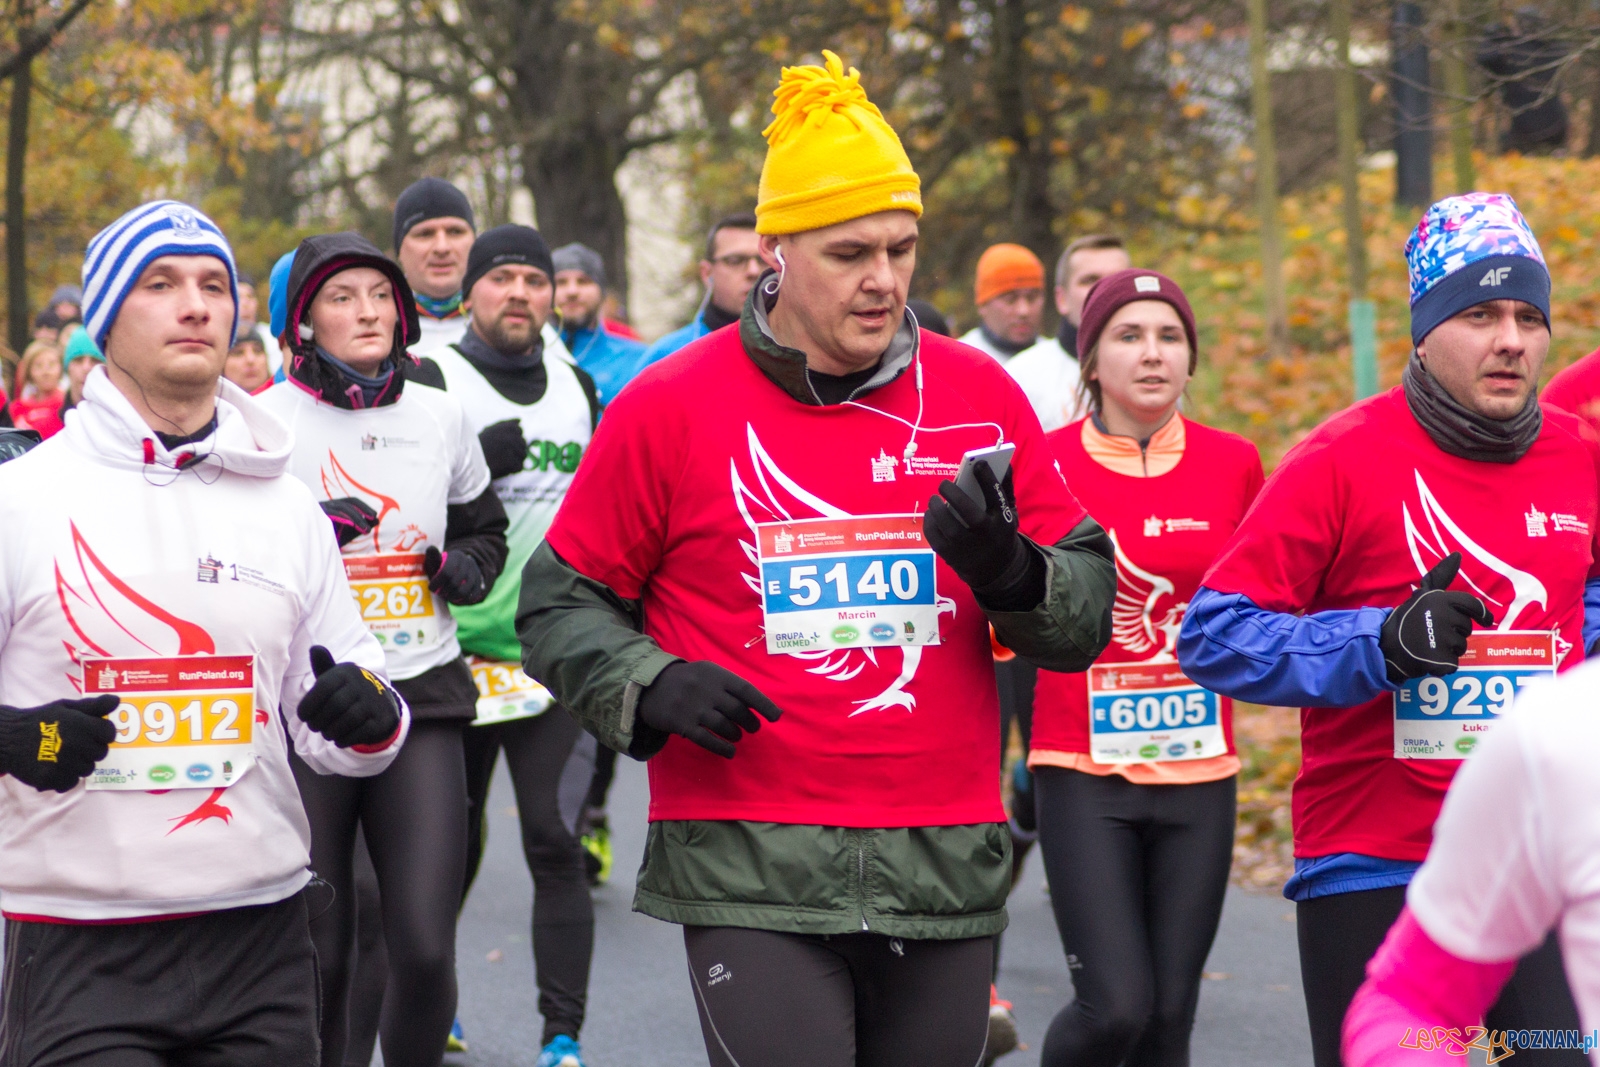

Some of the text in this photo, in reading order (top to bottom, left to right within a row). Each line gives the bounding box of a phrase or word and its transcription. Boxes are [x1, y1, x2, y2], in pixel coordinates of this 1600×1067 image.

[855, 531, 922, 542] RunPoland.org
[768, 560, 920, 606] E 5140
[838, 610, 876, 620] Marcin
[1424, 610, 1436, 648] accent
[776, 632, 804, 640] GRUPA
[776, 638, 810, 648] LUXMED
[1486, 647, 1546, 658] RunPoland.org
[178, 670, 244, 681] RunPoland.org
[1400, 688, 1412, 702] E
[1110, 692, 1208, 730] 6005
[107, 699, 240, 744] 9912
[1462, 723, 1492, 732] Łuka
[37, 721, 59, 763] EVERLAST
[1403, 738, 1430, 746] GRUPA
[94, 768, 121, 776] GRUPA
